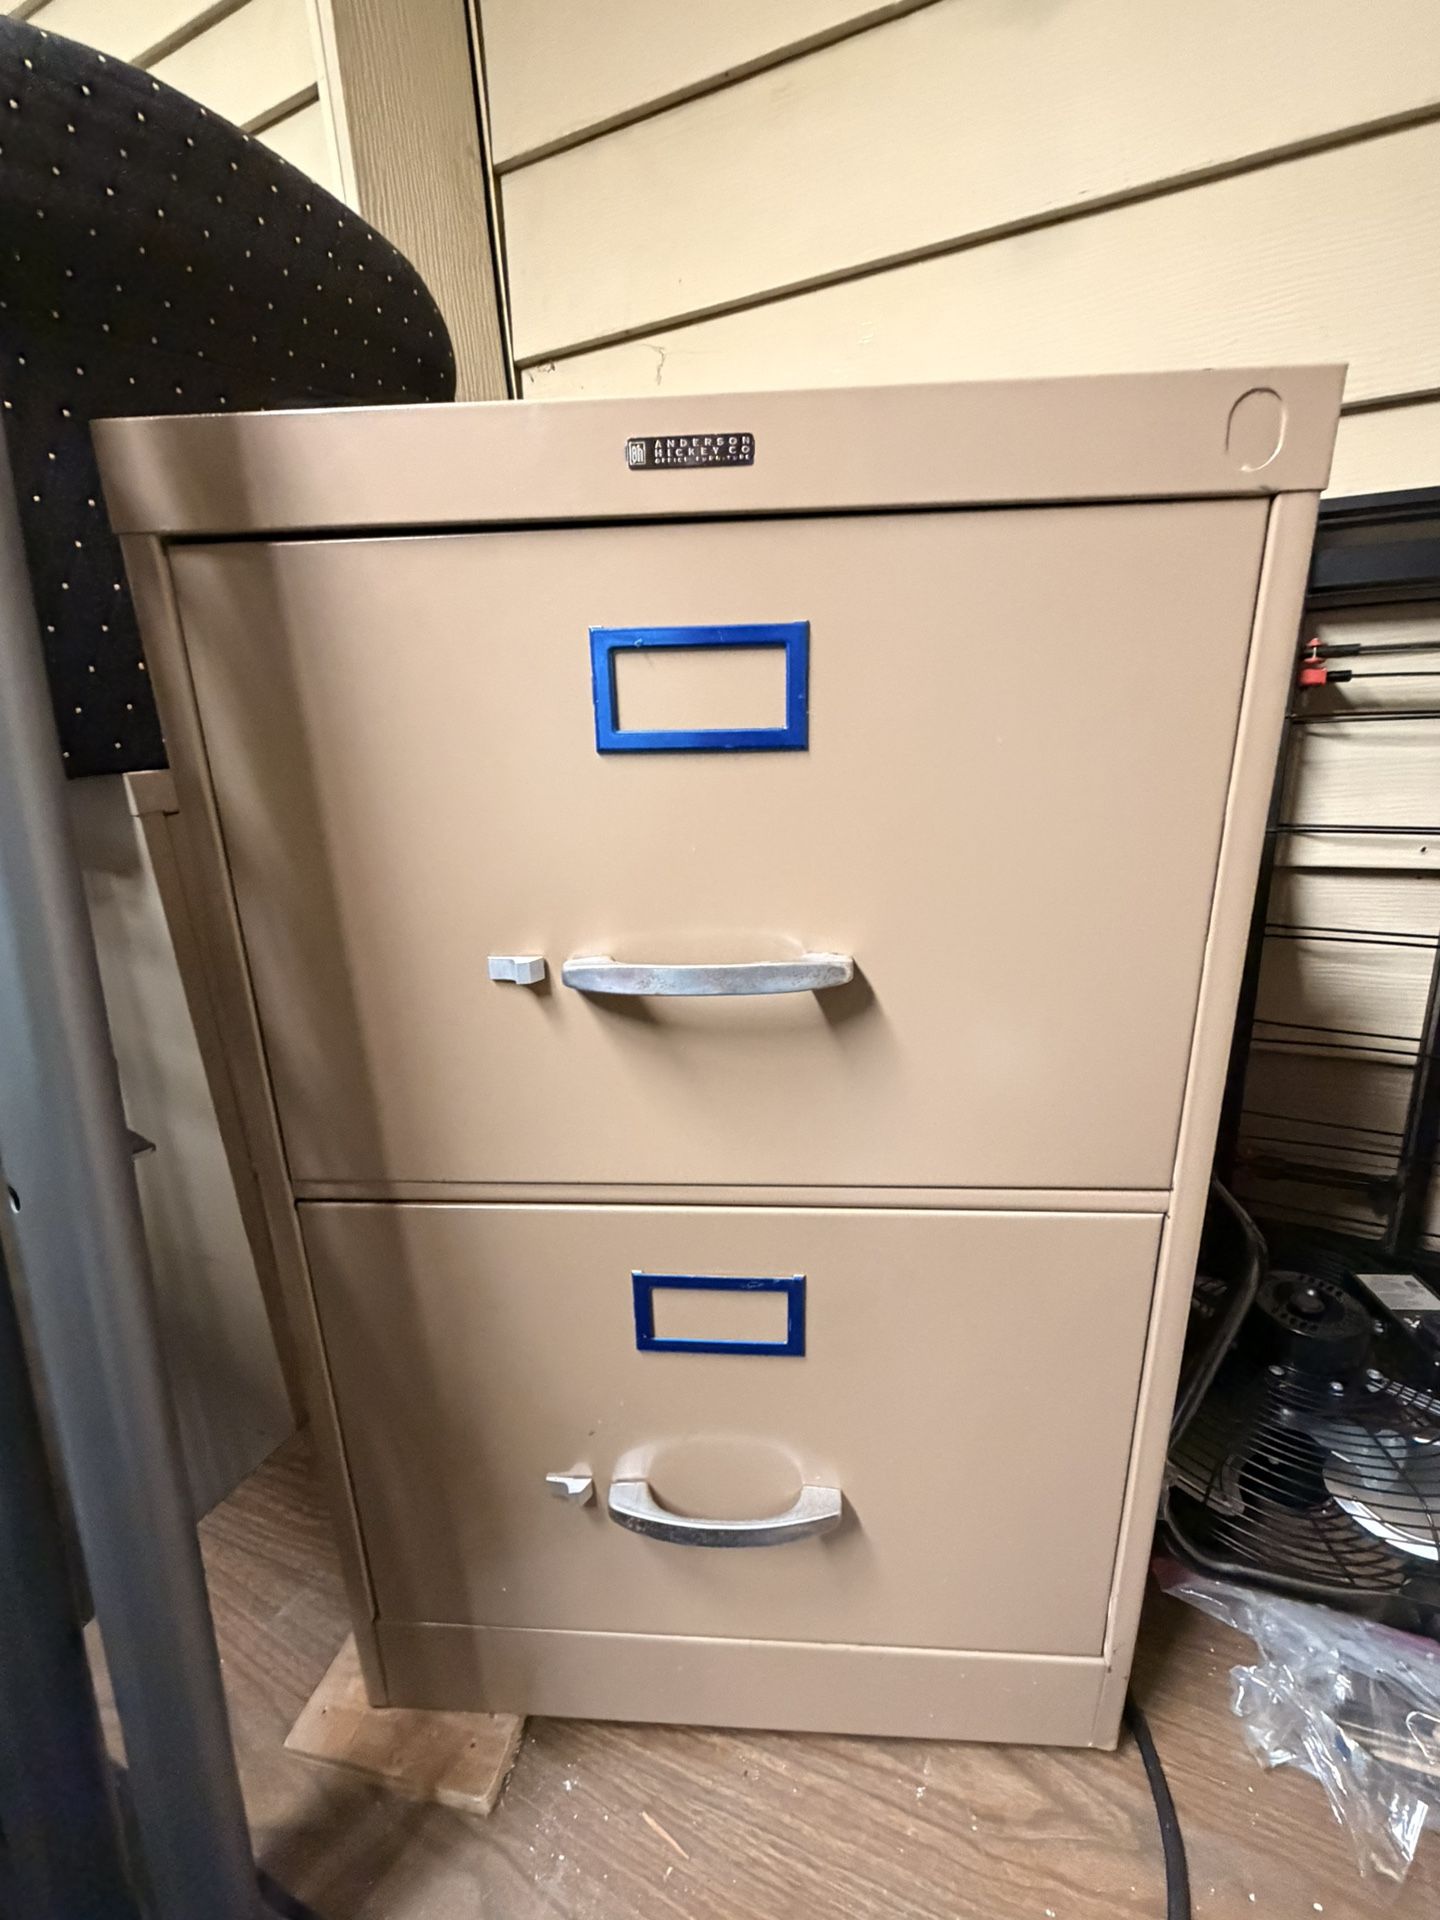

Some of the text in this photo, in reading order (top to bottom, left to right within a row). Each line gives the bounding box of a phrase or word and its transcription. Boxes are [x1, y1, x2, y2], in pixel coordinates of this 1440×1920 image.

[654, 436, 750, 448] ANDERSON
[654, 445, 750, 457] HICKEY CO
